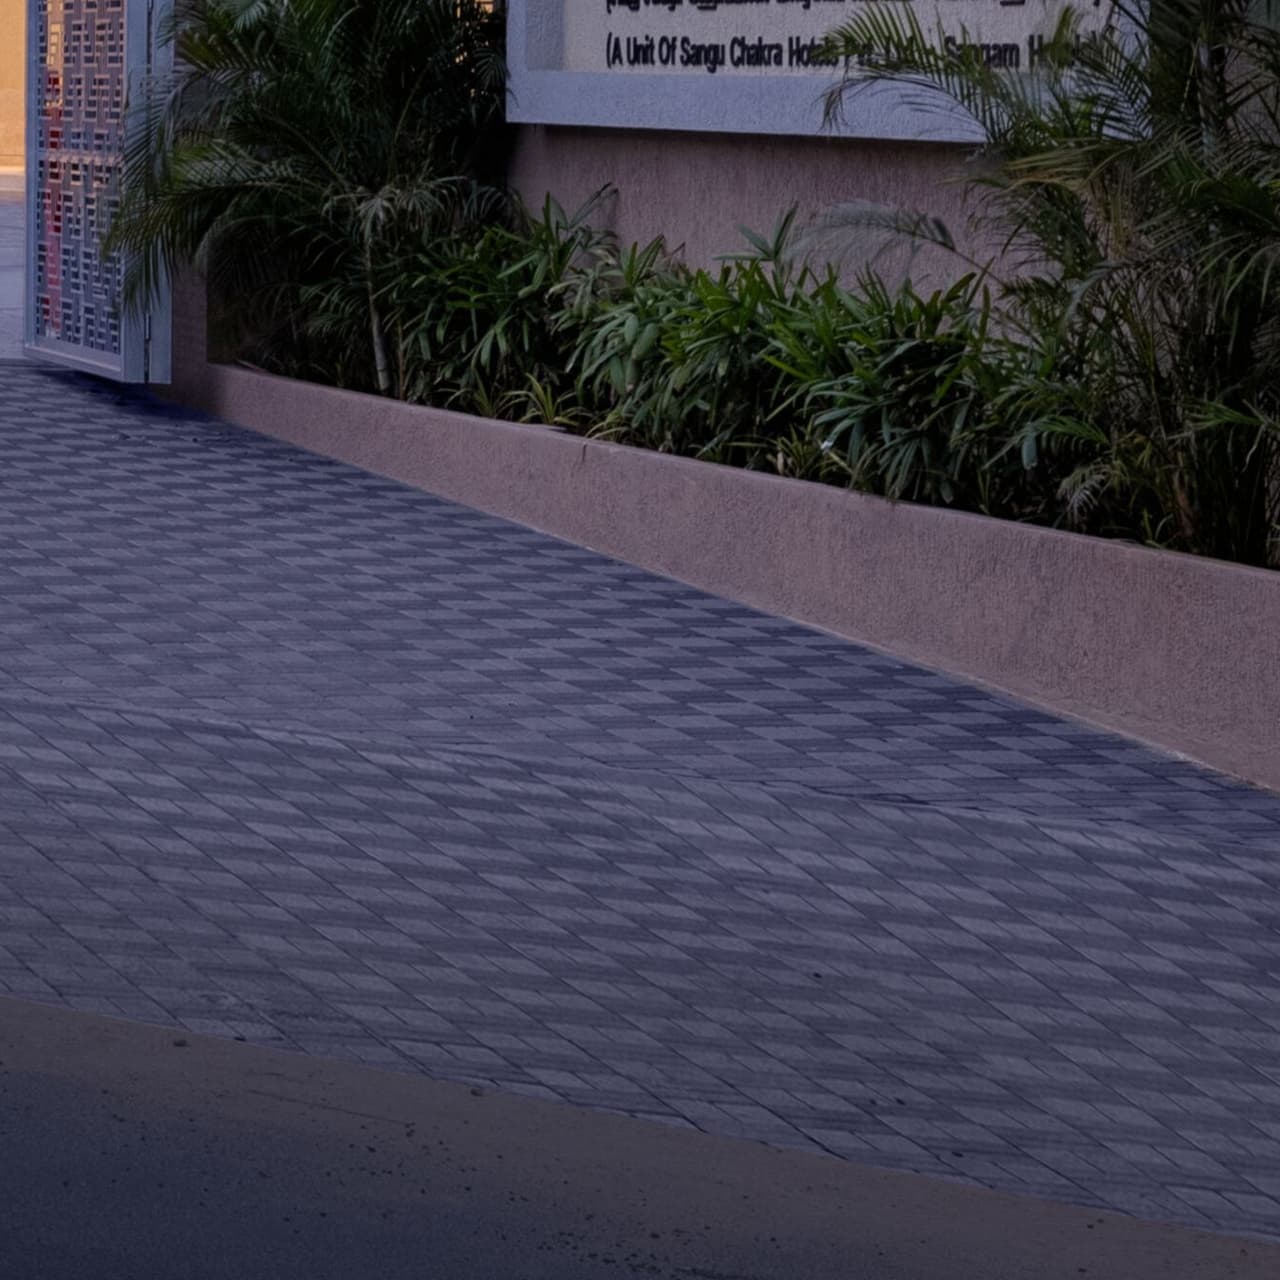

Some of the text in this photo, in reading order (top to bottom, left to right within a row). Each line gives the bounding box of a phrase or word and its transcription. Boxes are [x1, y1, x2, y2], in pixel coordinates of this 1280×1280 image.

[606, 32, 624, 68] (A
[626, 34, 655, 66] Unit
[657, 35, 678, 66] Of
[679, 35, 726, 74] Sangu
[729, 36, 783, 67] Chakra
